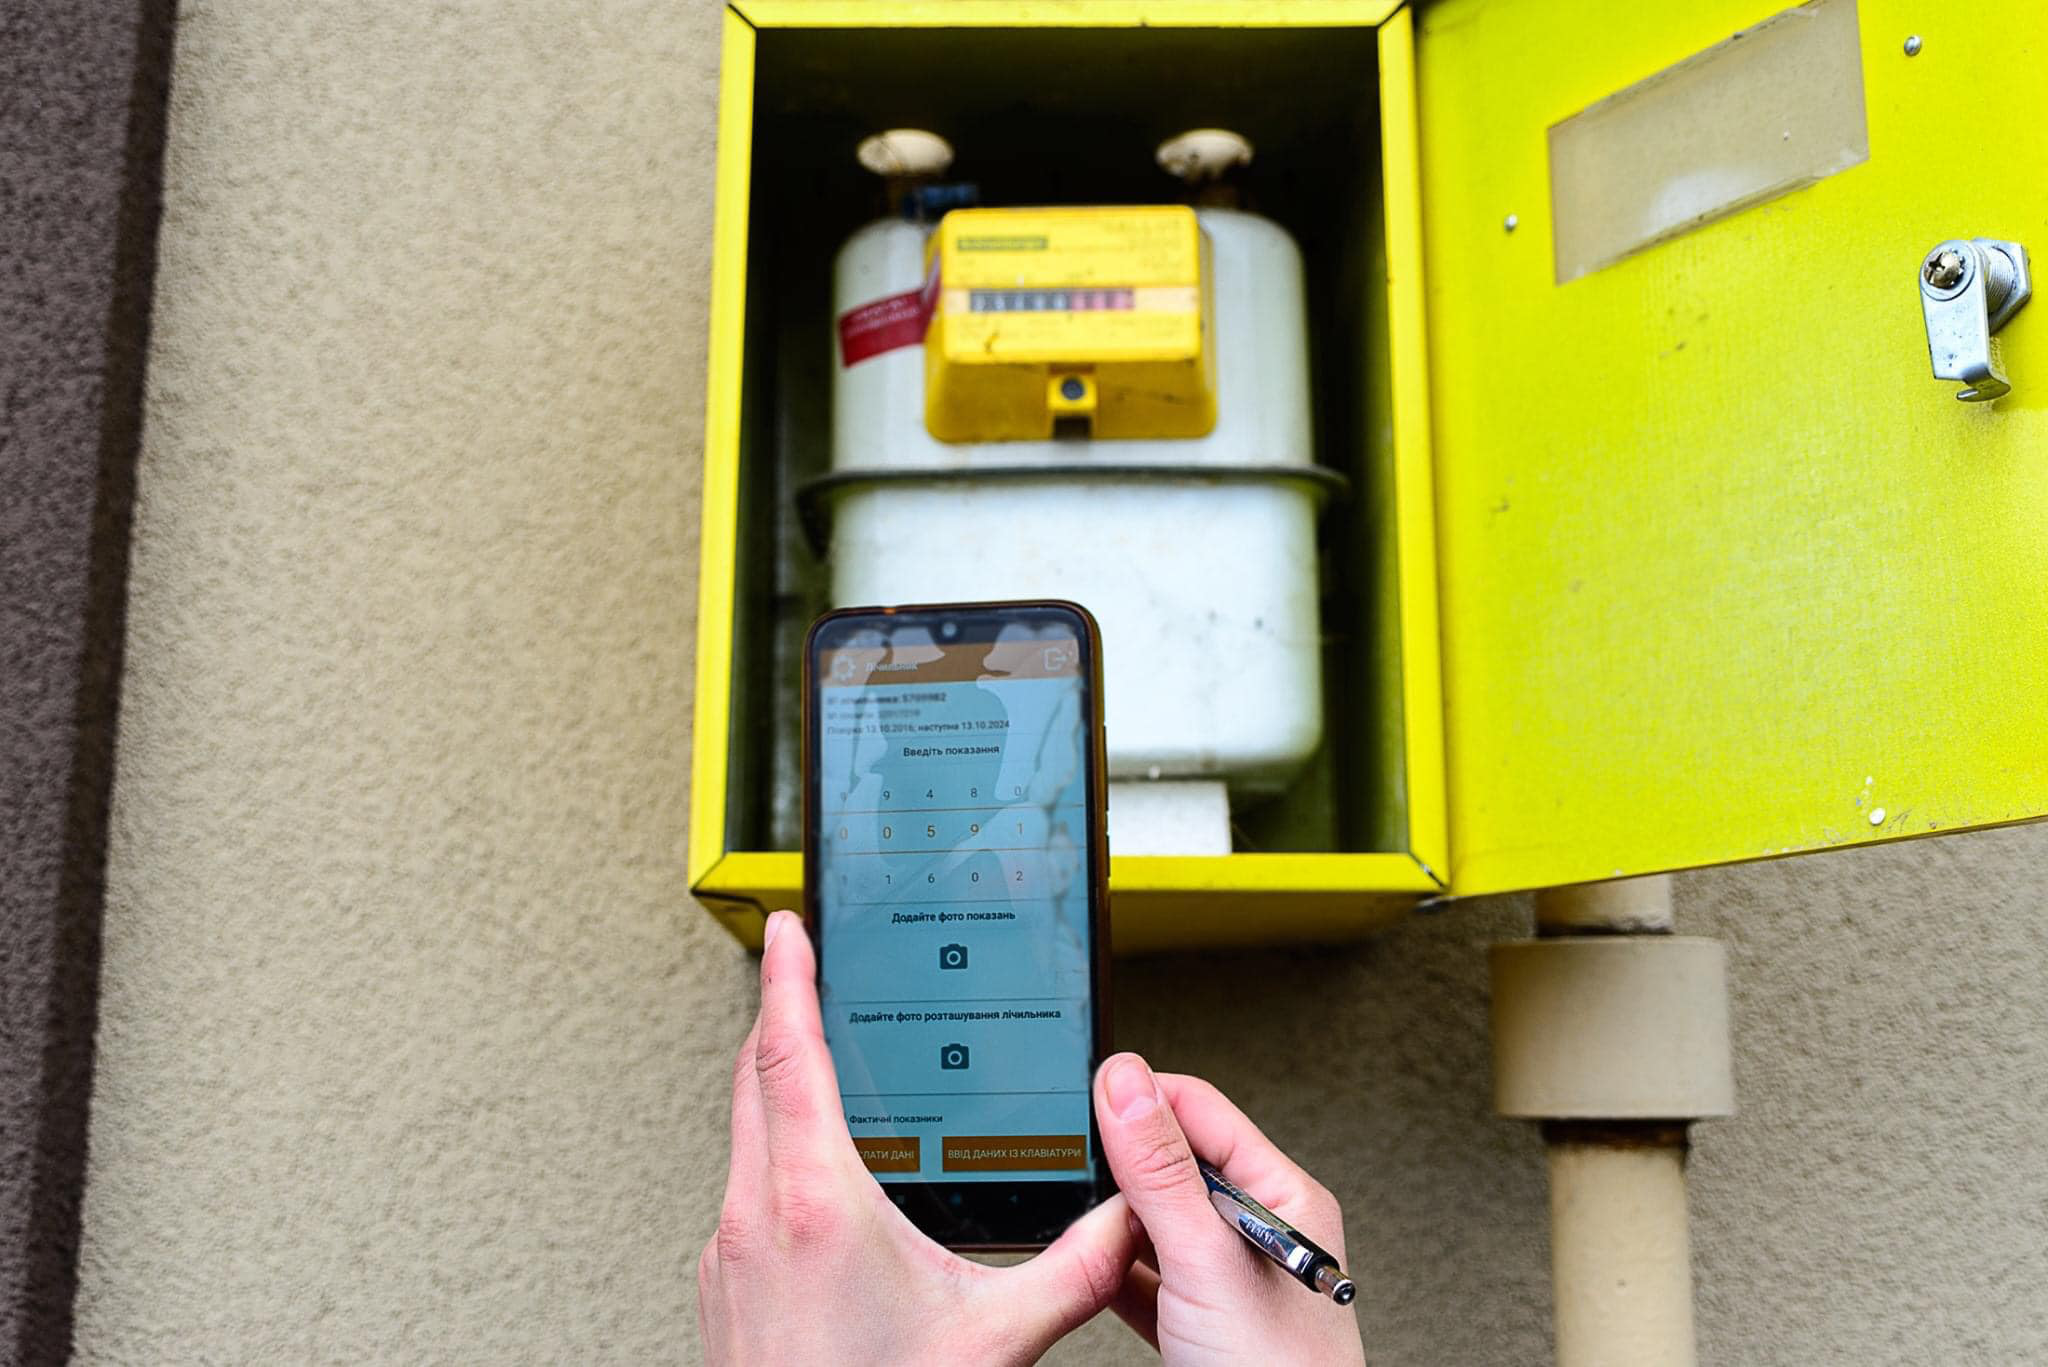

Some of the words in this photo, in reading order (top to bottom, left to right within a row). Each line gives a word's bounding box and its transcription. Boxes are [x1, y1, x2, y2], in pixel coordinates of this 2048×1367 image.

[918, 723, 959, 734] наступна
[961, 720, 1010, 731] 13.10.2024
[903, 746, 943, 758] Введіть
[945, 745, 1000, 756] показання
[883, 791, 890, 800] 9
[925, 789, 934, 800] 4
[970, 788, 978, 798] 8
[1014, 786, 1022, 797] 0
[883, 826, 891, 839] 0
[927, 825, 936, 838] 5
[970, 823, 979, 836] 9
[1017, 822, 1023, 834] 1
[885, 874, 891, 885] 1
[928, 872, 935, 883] 6
[971, 872, 979, 882] 0
[1016, 871, 1023, 881] 2
[892, 912, 936, 924] Додайте
[938, 911, 964, 923] фото
[966, 910, 1015, 921] показань
[849, 1012, 893, 1024] Додайте
[896, 1011, 922, 1023] фото
[924, 1011, 999, 1022] розташування
[1002, 1009, 1061, 1020] лічильника
[849, 1114, 892, 1124] Фактичні
[893, 1115, 943, 1124] показники
[890, 1150, 914, 1161] ДАНІ
[948, 1149, 971, 1160] ВВІД
[972, 1149, 1007, 1160] ДАНИХ
[1009, 1149, 1019, 1158] ІЗ
[1020, 1148, 1082, 1158] КЛАВІАТУРИ
